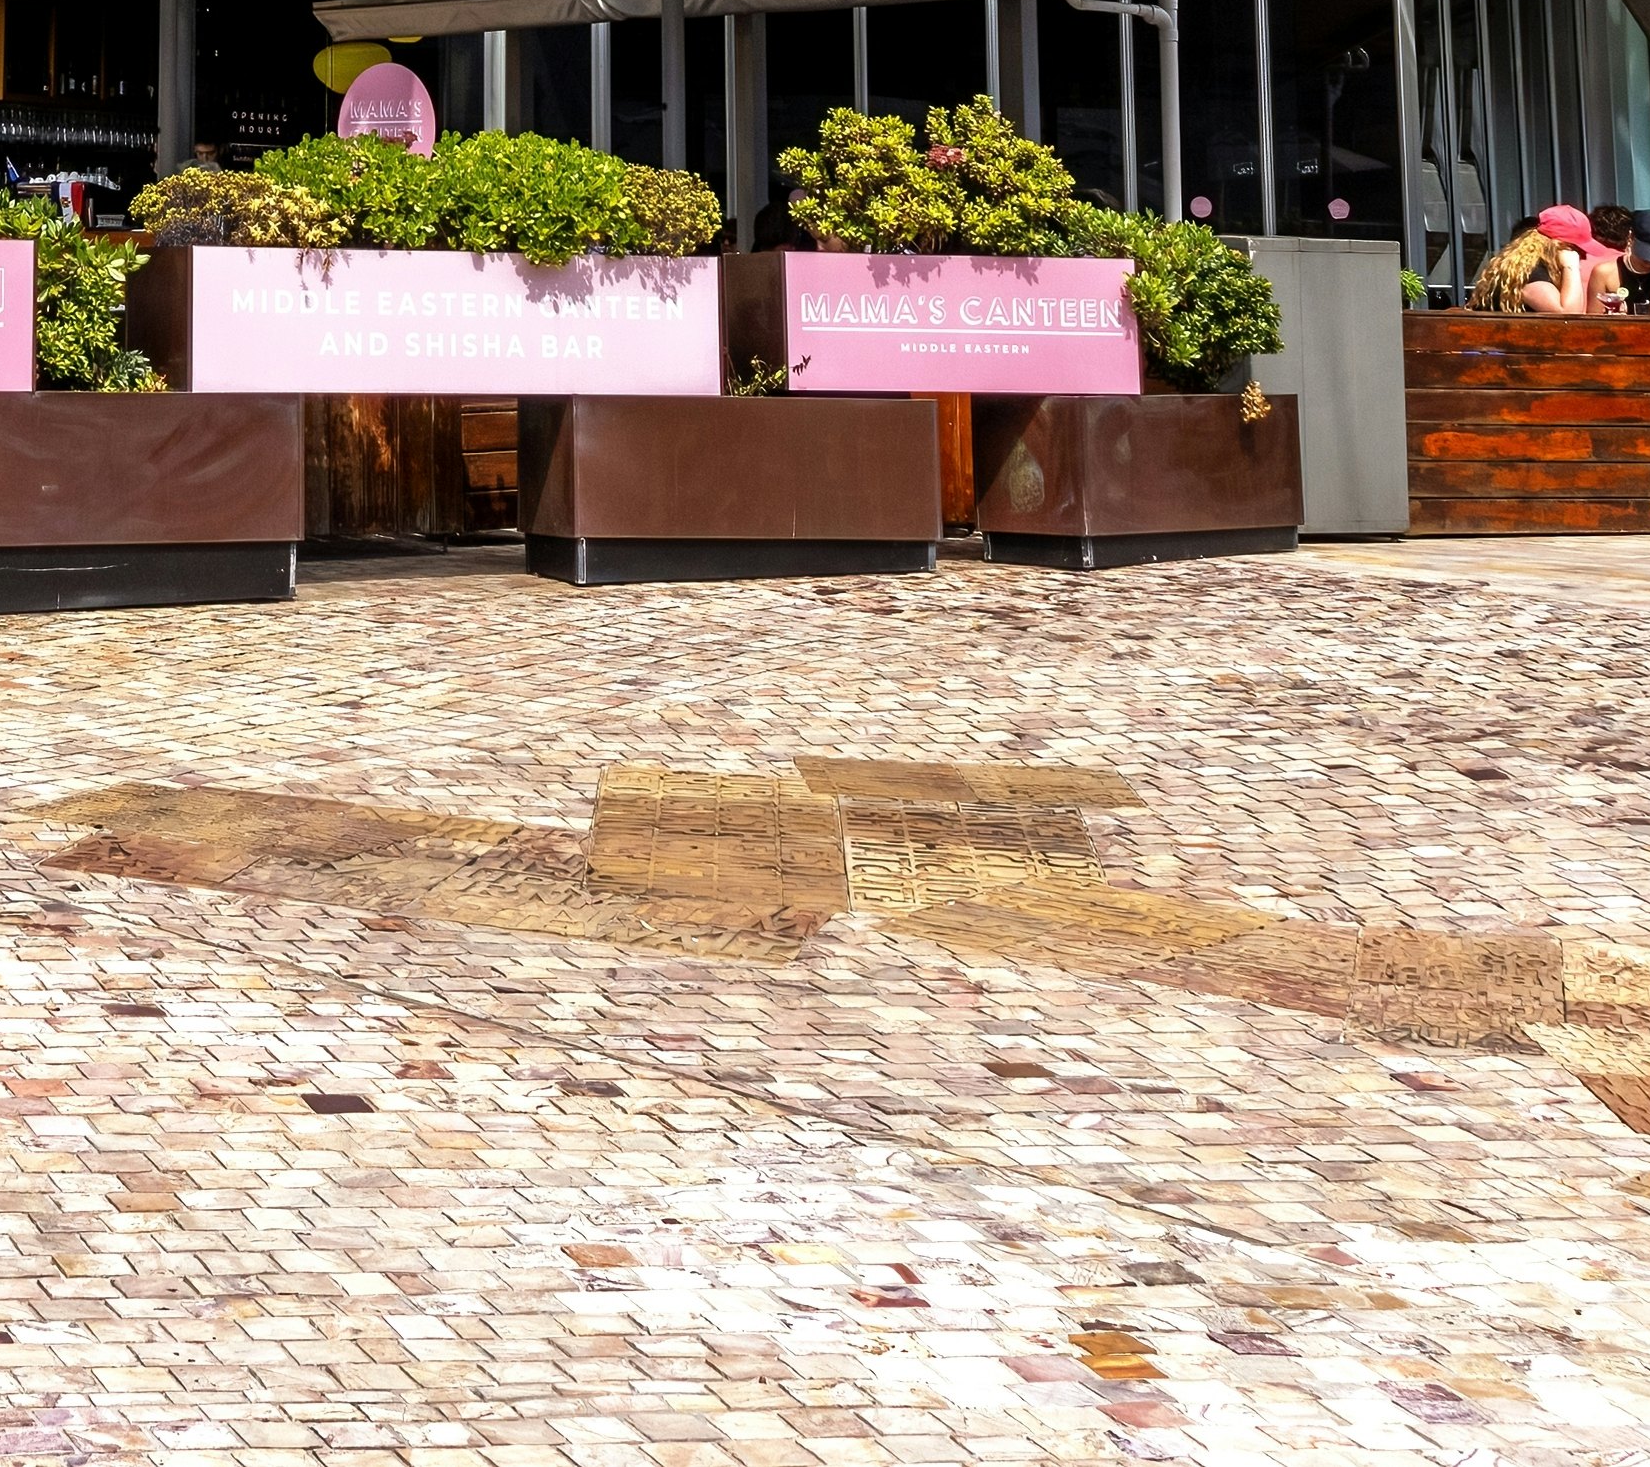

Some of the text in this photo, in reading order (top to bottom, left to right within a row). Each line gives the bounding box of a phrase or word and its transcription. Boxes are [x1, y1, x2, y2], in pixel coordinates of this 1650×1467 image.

[231, 110, 288, 122] OPENING
[350, 100, 422, 118] MAMA'S
[231, 288, 685, 321] MIDDLE EASTERN CANTEEN
[800, 293, 1122, 329] MAMA'S CANTEEN
[319, 331, 605, 359] AND SHISHA BAR
[900, 343, 1030, 354] MIDDLE EASTERN
